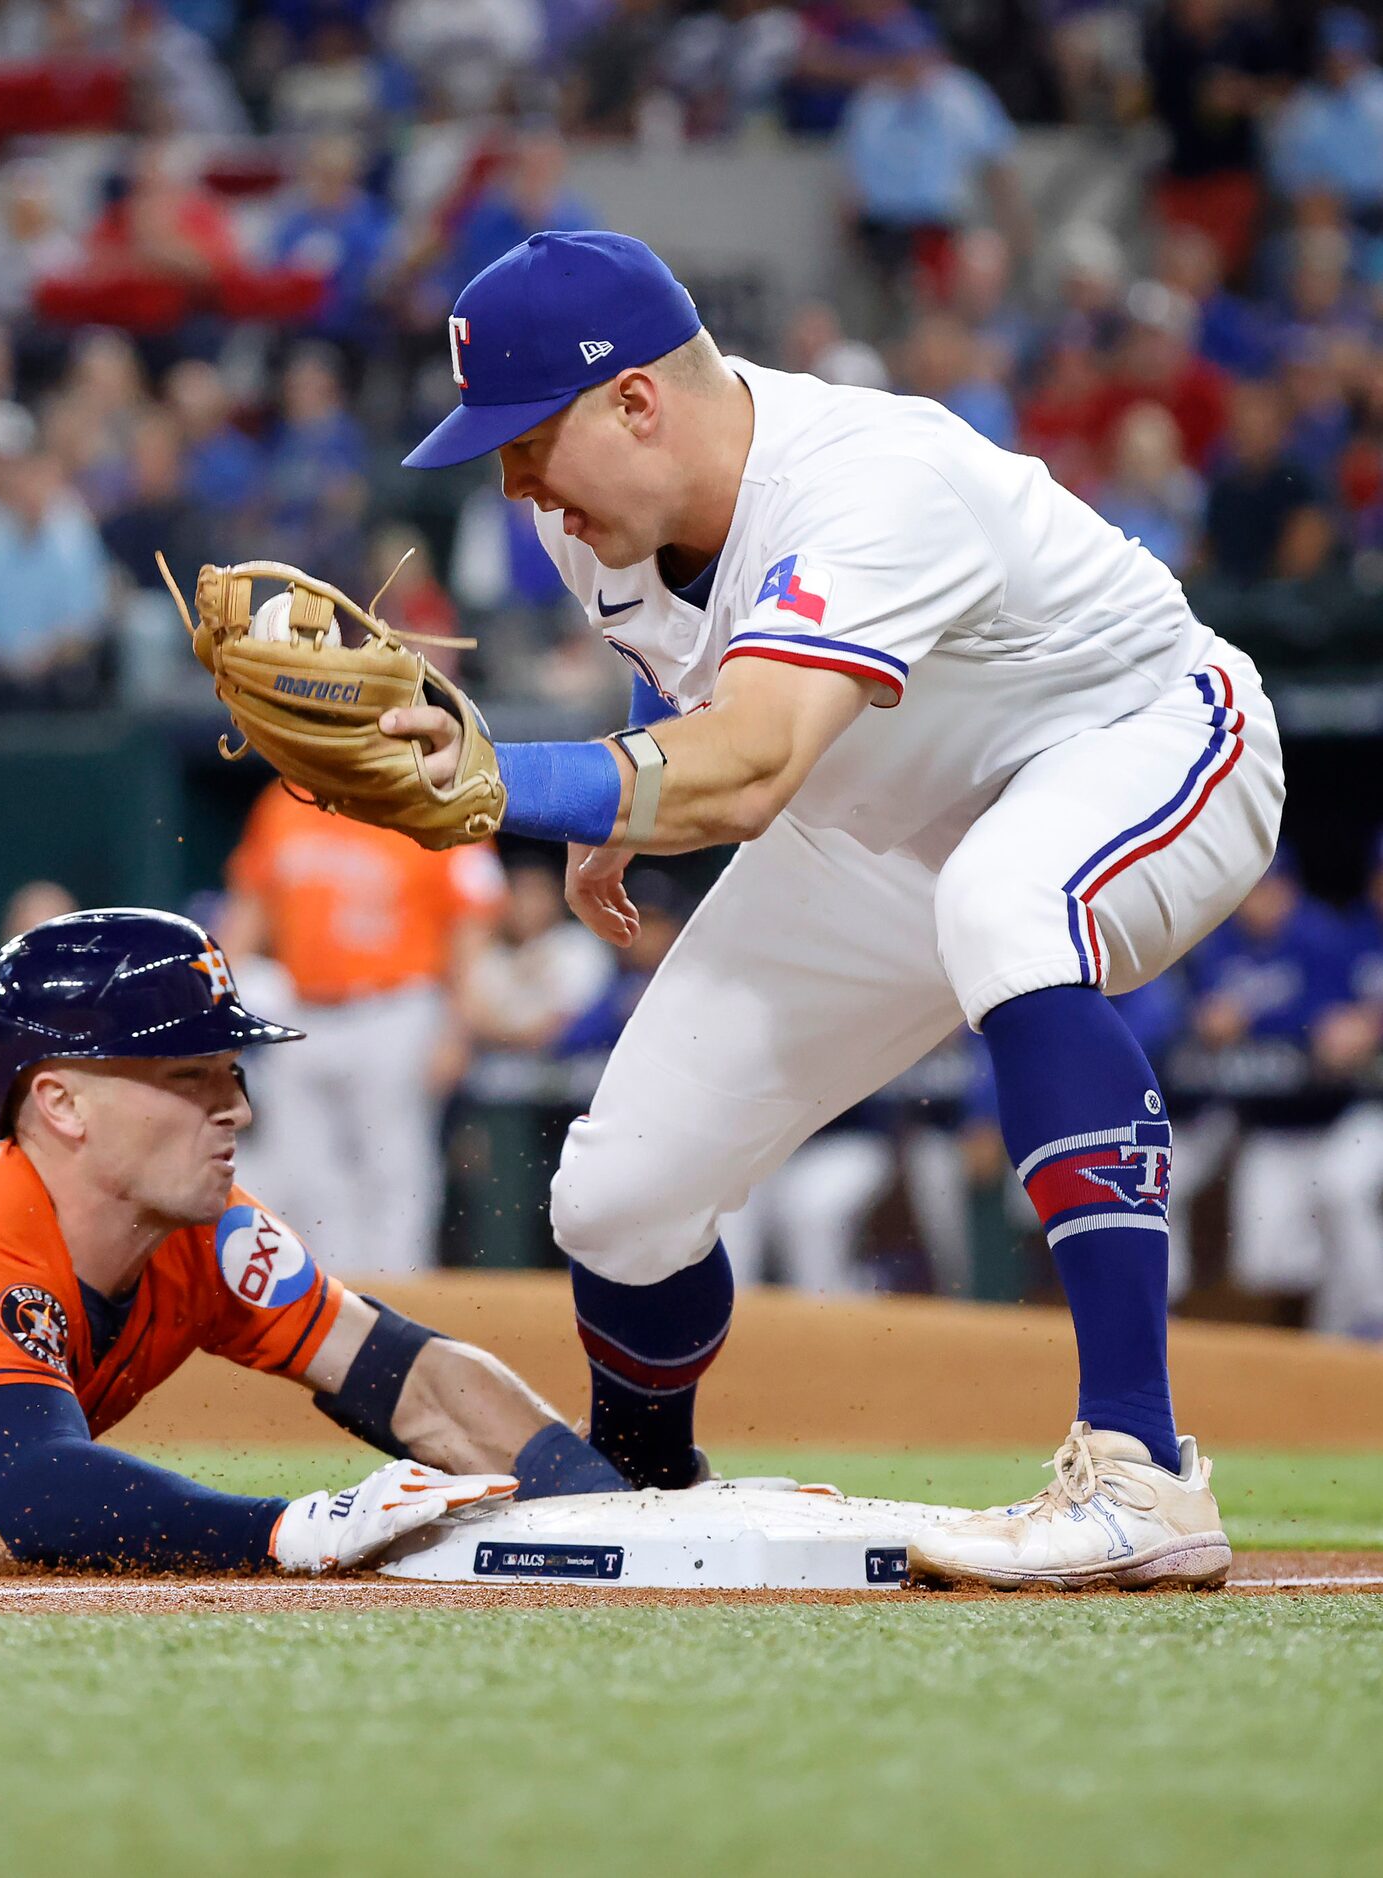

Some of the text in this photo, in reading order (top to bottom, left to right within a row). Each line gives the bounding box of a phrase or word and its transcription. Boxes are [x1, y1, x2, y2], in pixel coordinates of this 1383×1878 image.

[273, 673, 364, 705] marucci
[238, 1214, 282, 1302] OXY
[480, 1549, 493, 1568] T
[517, 1554, 545, 1567] ALCS
[604, 1554, 618, 1572] T
